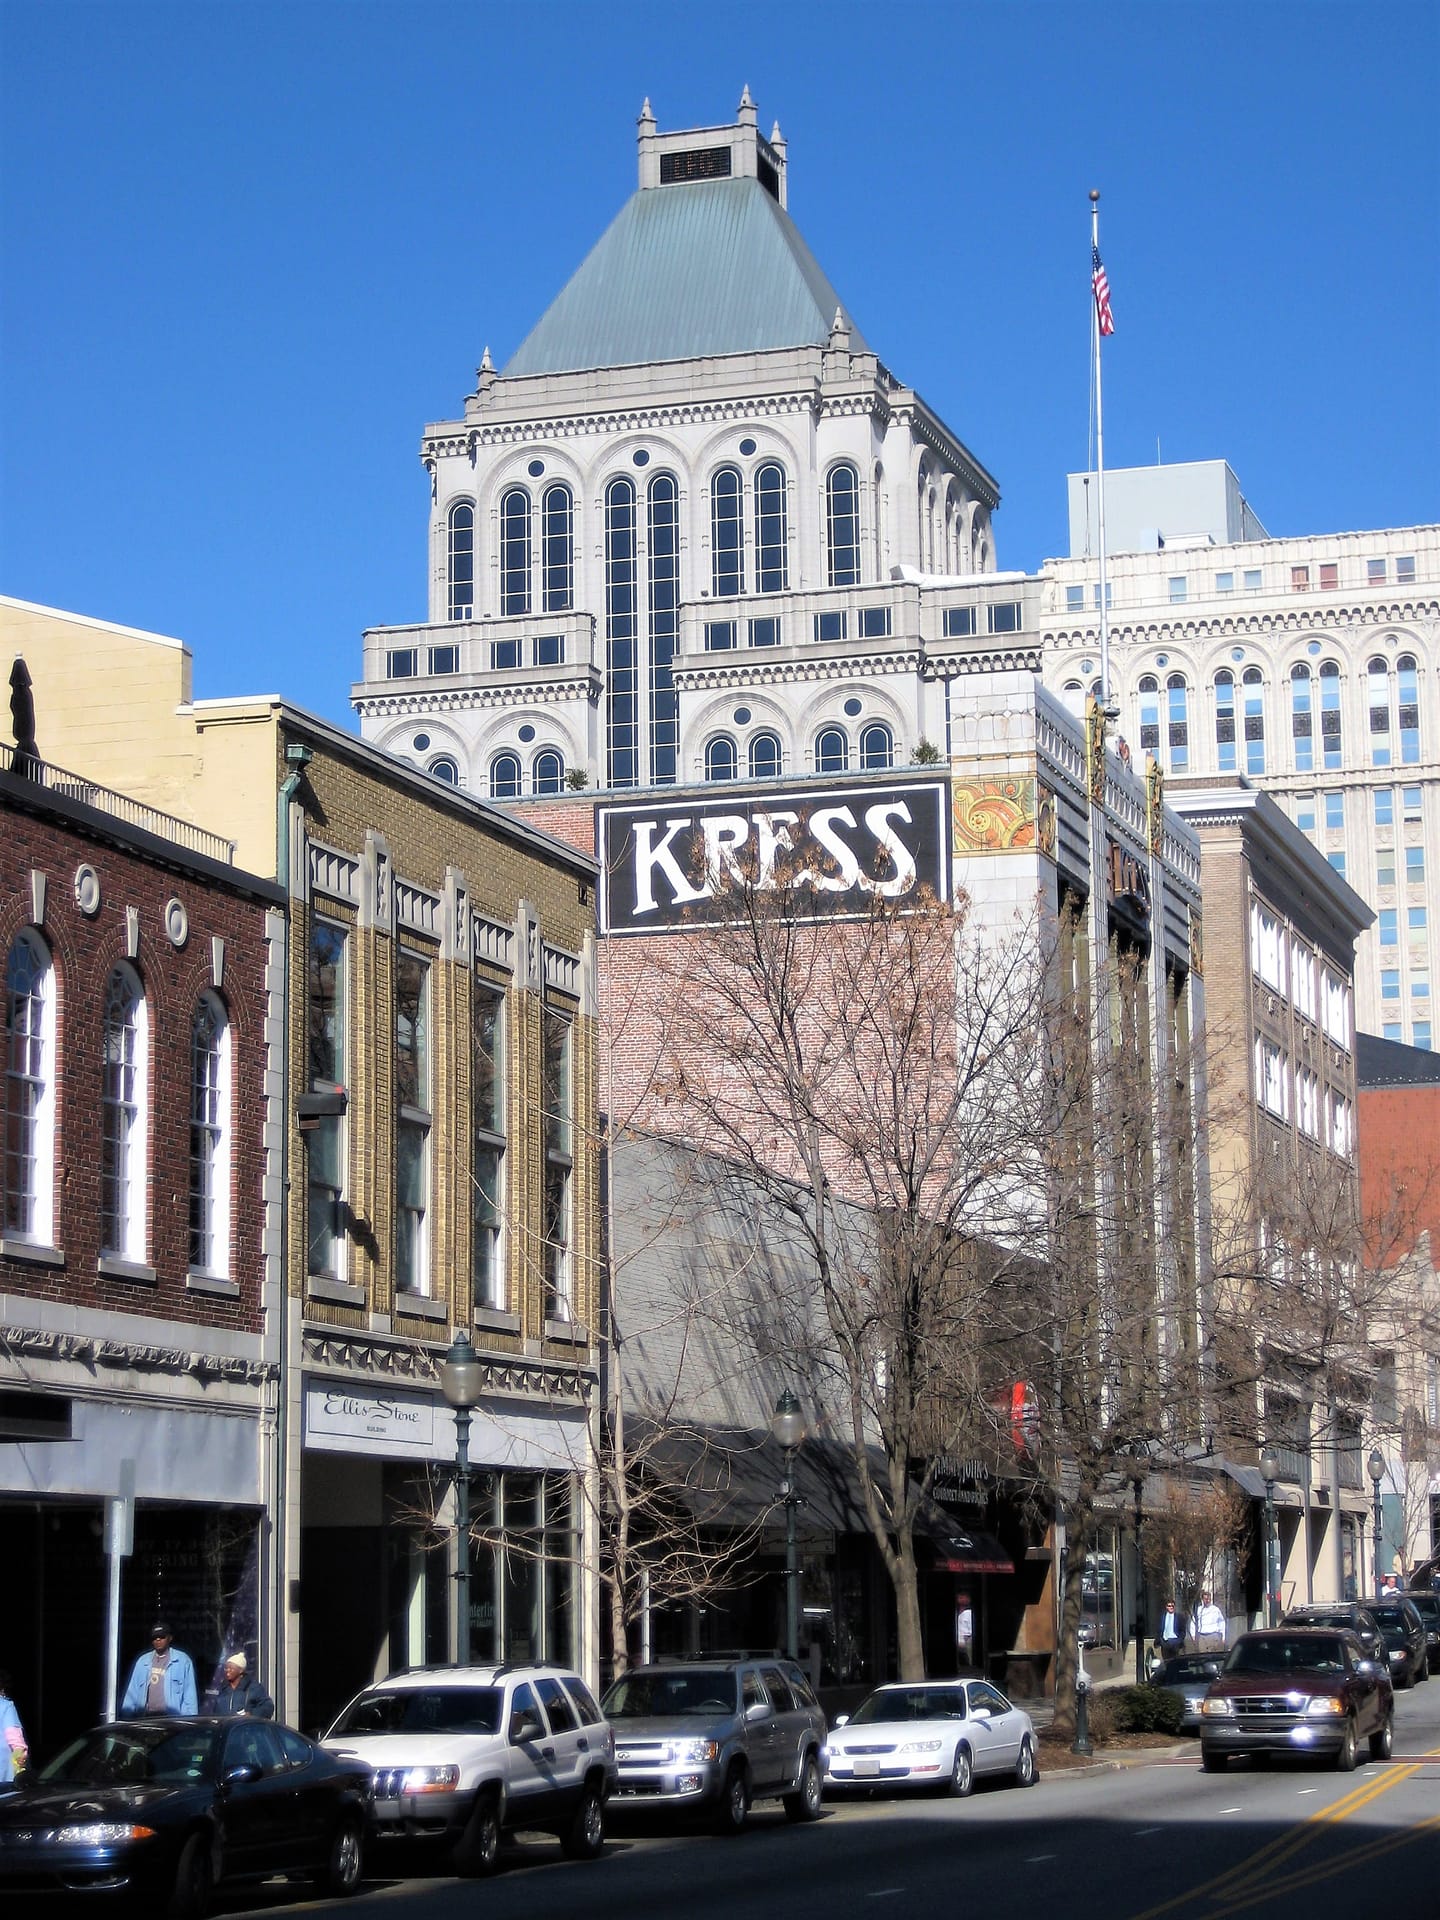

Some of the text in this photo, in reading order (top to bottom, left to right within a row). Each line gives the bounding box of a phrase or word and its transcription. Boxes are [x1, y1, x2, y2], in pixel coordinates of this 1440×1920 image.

[632, 799, 917, 916] KRESS
[323, 1388, 421, 1423] Ellis Stone
